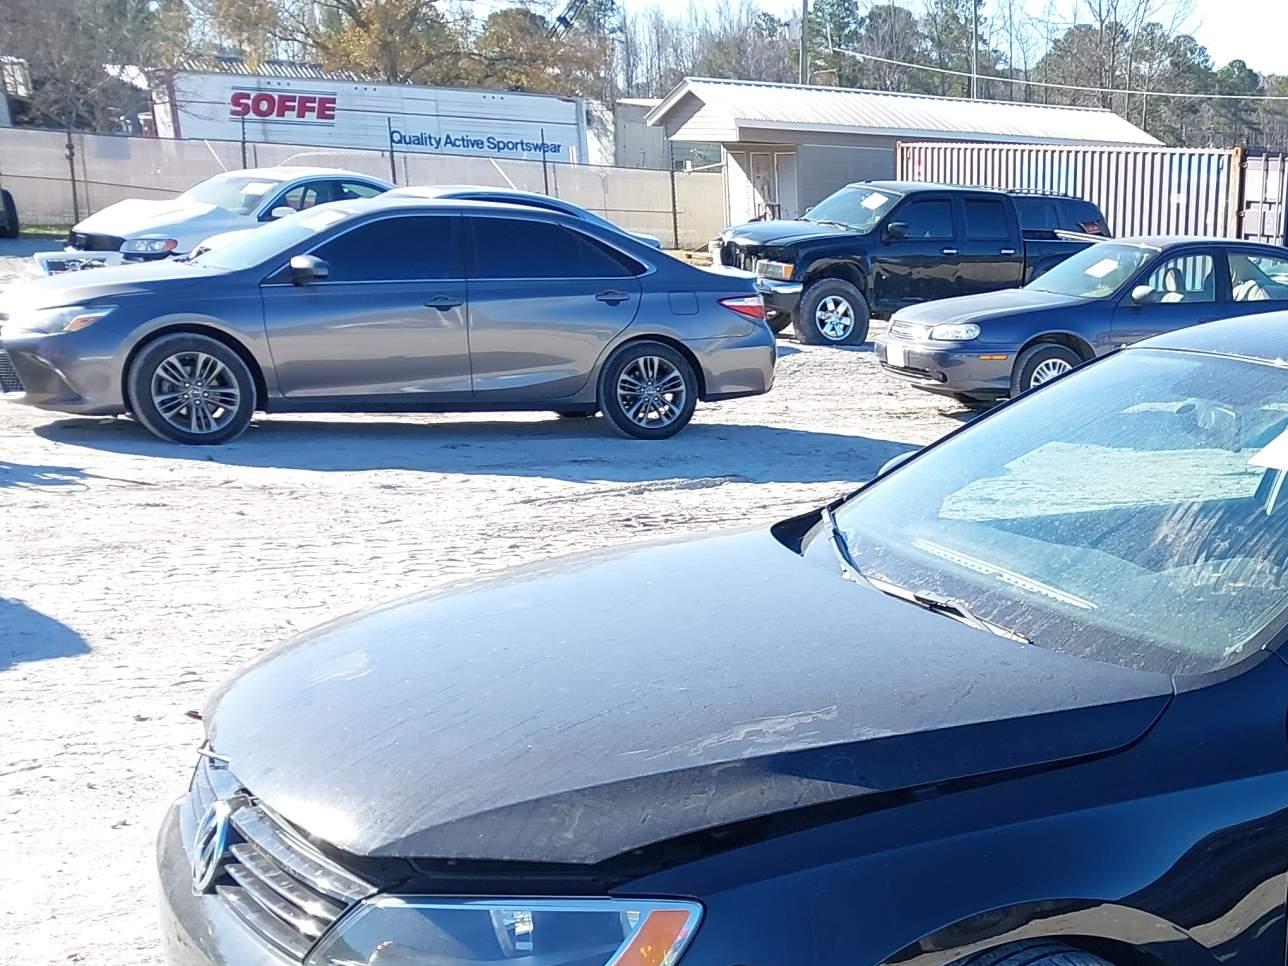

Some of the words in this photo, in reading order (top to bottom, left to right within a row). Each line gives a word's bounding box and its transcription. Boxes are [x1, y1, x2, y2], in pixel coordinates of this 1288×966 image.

[229, 91, 337, 120] SOFFE
[390, 130, 442, 149] Quality
[443, 134, 484, 150] Active
[486, 136, 562, 153] Sportswear
